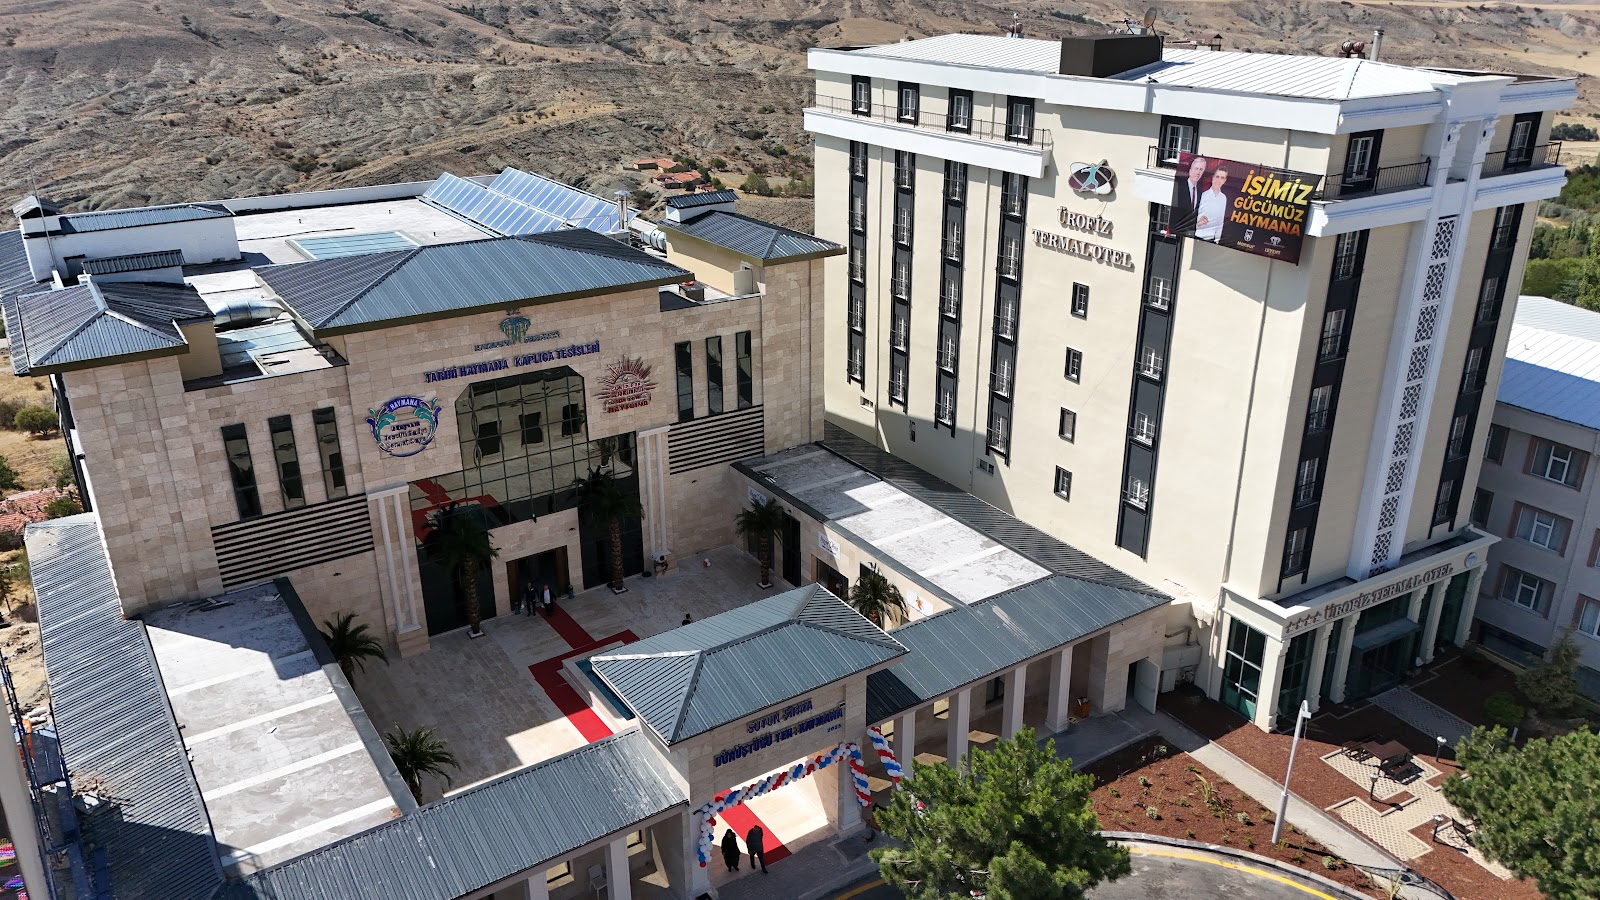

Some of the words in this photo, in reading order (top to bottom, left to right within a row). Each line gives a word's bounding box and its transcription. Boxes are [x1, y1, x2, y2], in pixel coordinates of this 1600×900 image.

[1241, 169, 1313, 206] İŞİMİZ
[1057, 206, 1112, 235] ÜROFİZ
[1233, 195, 1305, 222] GÜCÜMÜZ
[1230, 210, 1300, 237] HAYMANA
[1032, 229, 1091, 256] TERMAL
[1092, 244, 1132, 268] OTEL
[460, 359, 509, 377] HAYMANA
[389, 399, 418, 410] HAYMANA
[1324, 592, 1372, 620] ÜROFİZ
[1371, 575, 1422, 601] TERMAL
[1422, 563, 1454, 583] OTEL
[746, 710, 780, 733] SUYUN
